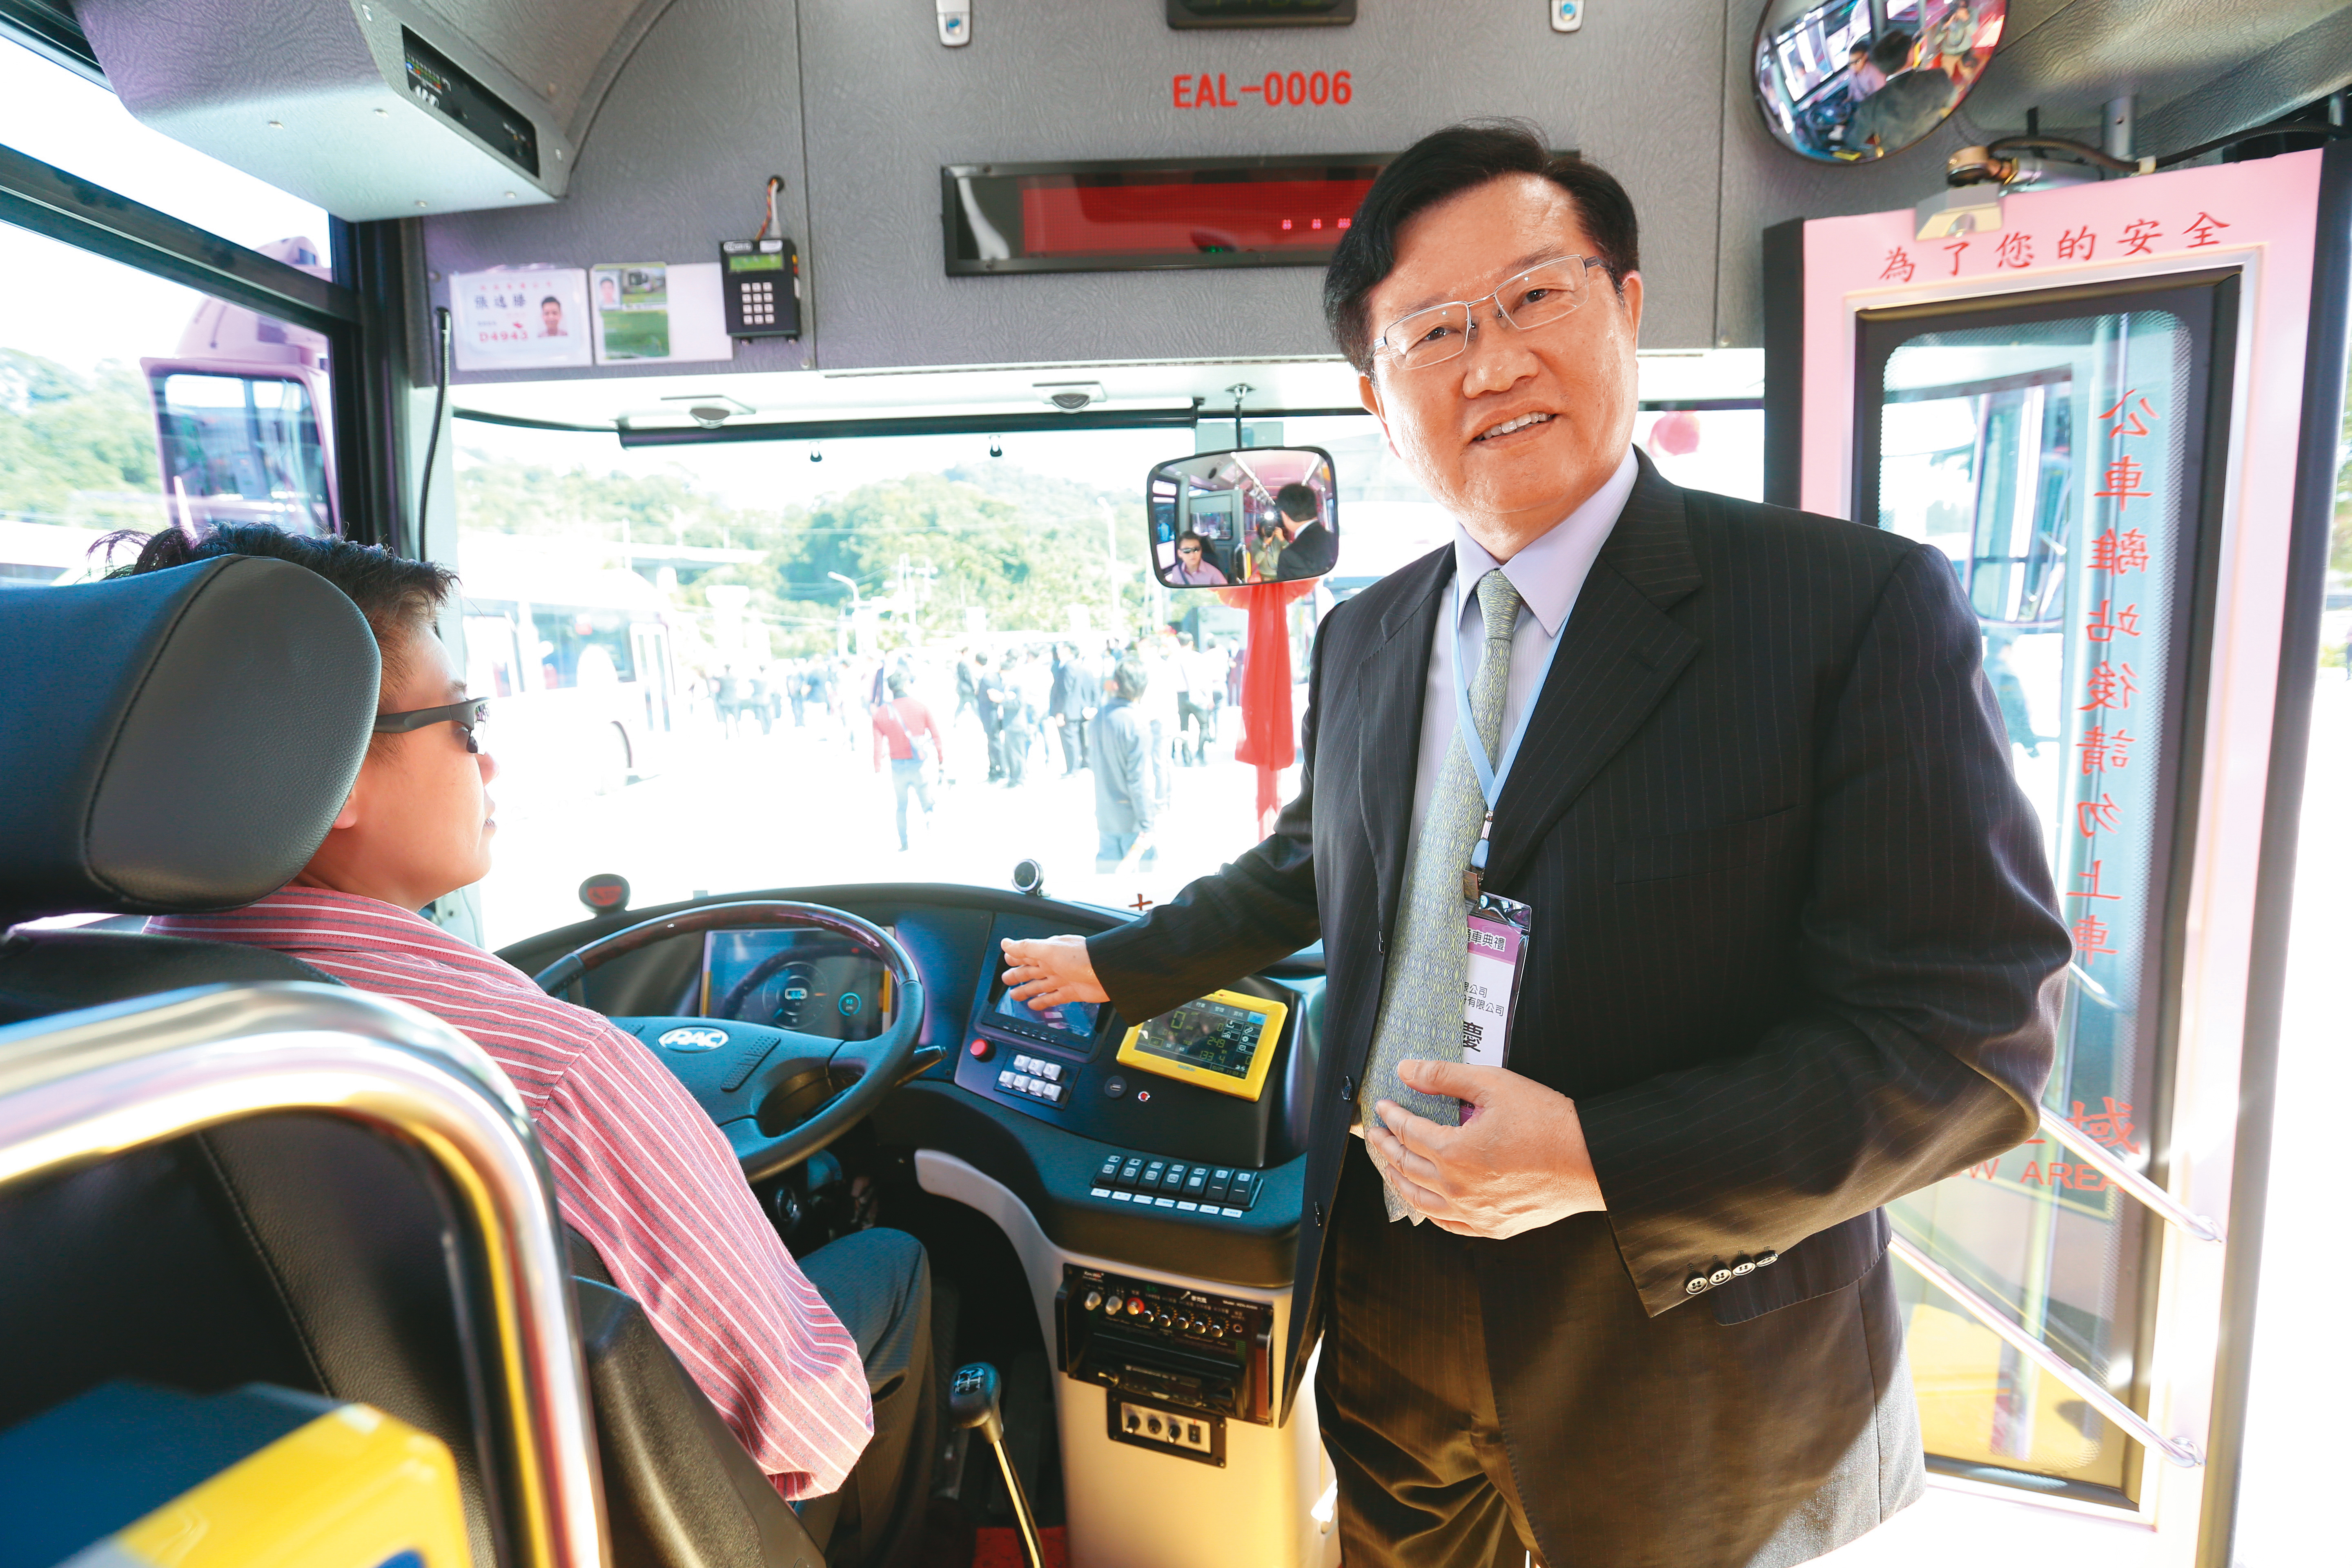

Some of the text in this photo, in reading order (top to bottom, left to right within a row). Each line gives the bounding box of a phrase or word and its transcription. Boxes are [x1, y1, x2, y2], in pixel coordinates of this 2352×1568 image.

[1172, 69, 1353, 109] EAL-0006
[1879, 212, 2231, 283] 為了您的安全
[1464, 995, 1504, 1017] 有限公司
[1171, 1011, 1186, 1030] 0
[1207, 1036, 1225, 1048] 249
